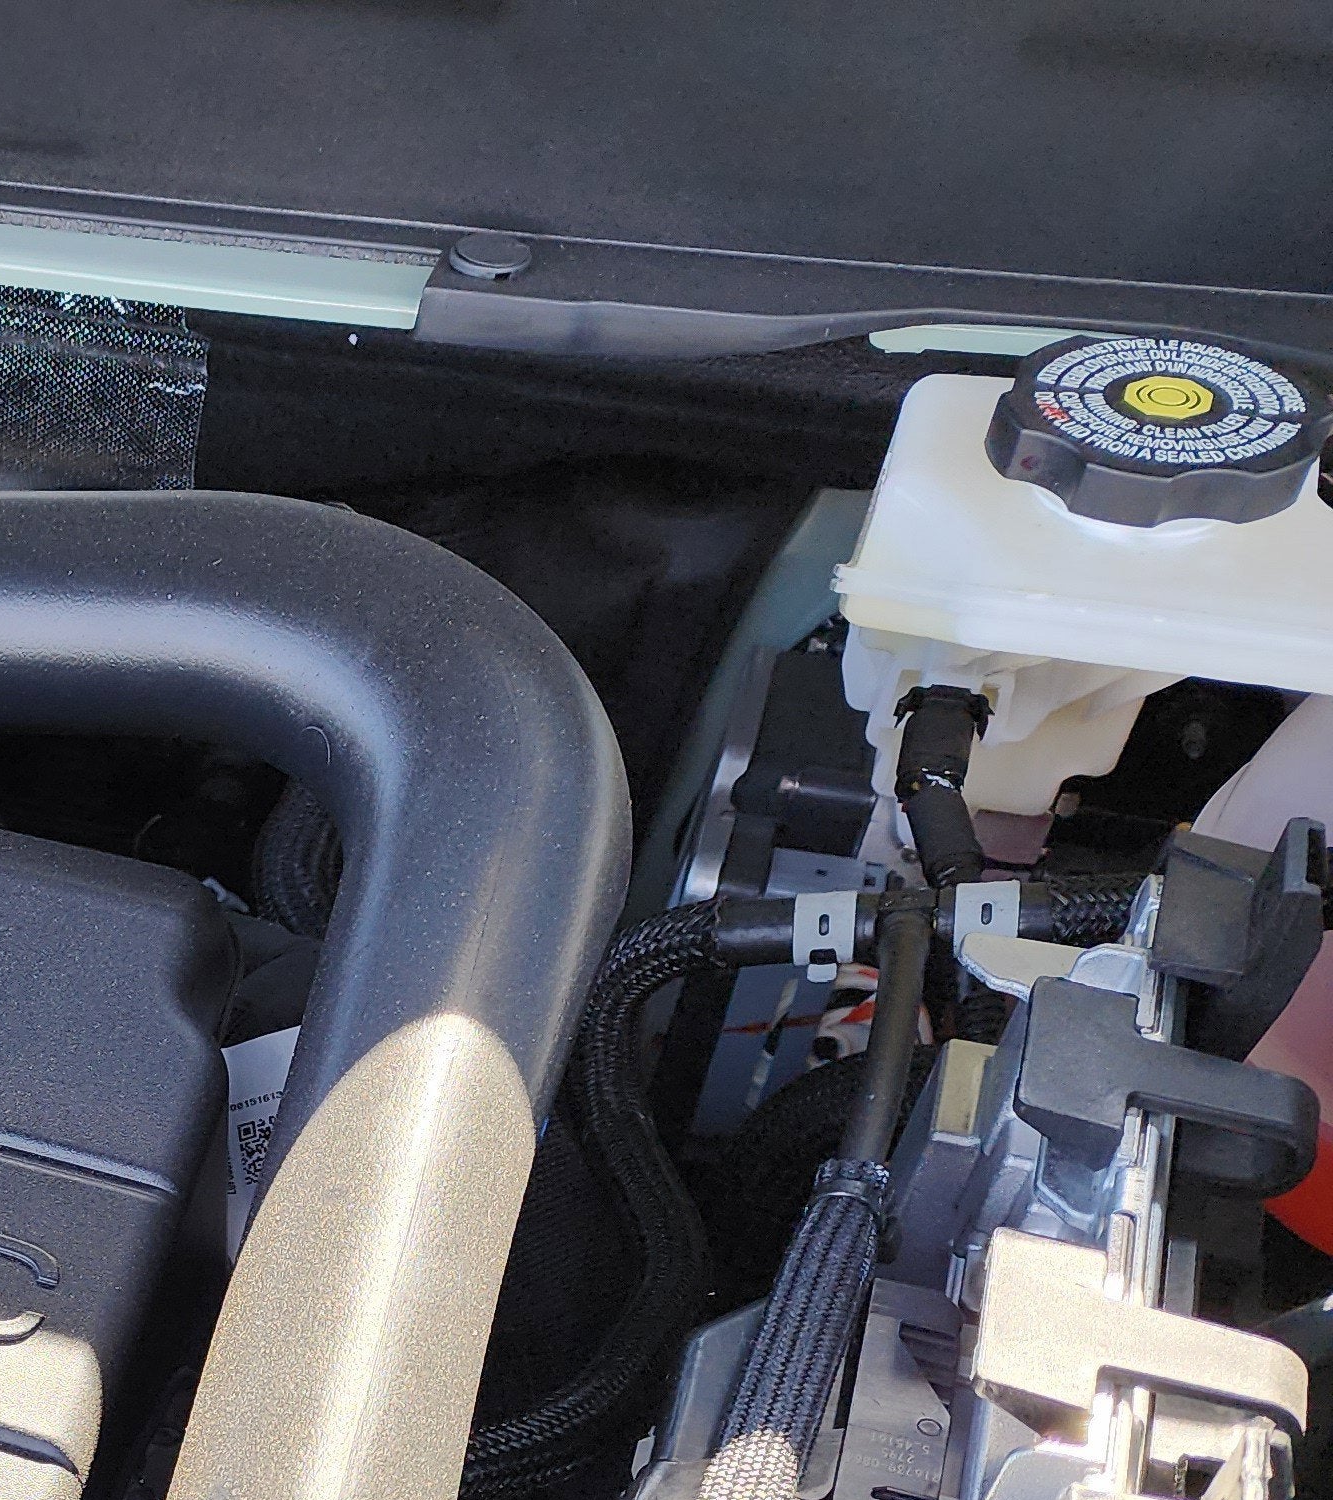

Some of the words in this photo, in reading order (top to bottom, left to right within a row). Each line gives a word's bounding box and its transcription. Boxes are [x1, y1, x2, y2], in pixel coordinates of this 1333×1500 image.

[1117, 350, 1150, 362] QUE
[1149, 350, 1171, 360] DU
[1171, 351, 1228, 371] LIQUIDE
[1221, 364, 1248, 378] DE
[1236, 372, 1273, 396] FREIN
[1155, 361, 1188, 373] D'UN
[1186, 365, 1231, 386] BIDON
[1160, 339, 1179, 350] LE
[1180, 341, 1250, 364] BOUCHON
[1242, 361, 1288, 384] AVANT
[1058, 391, 1084, 410] CAP
[1068, 408, 1125, 439] BEFORE
[1142, 424, 1203, 439] CLEAN
[1200, 412, 1250, 436] FILLER
[1239, 416, 1275, 439] ONLY
[1083, 432, 1140, 458] FROM
[1135, 447, 1152, 461] A
[1153, 449, 1226, 464] SEALED
